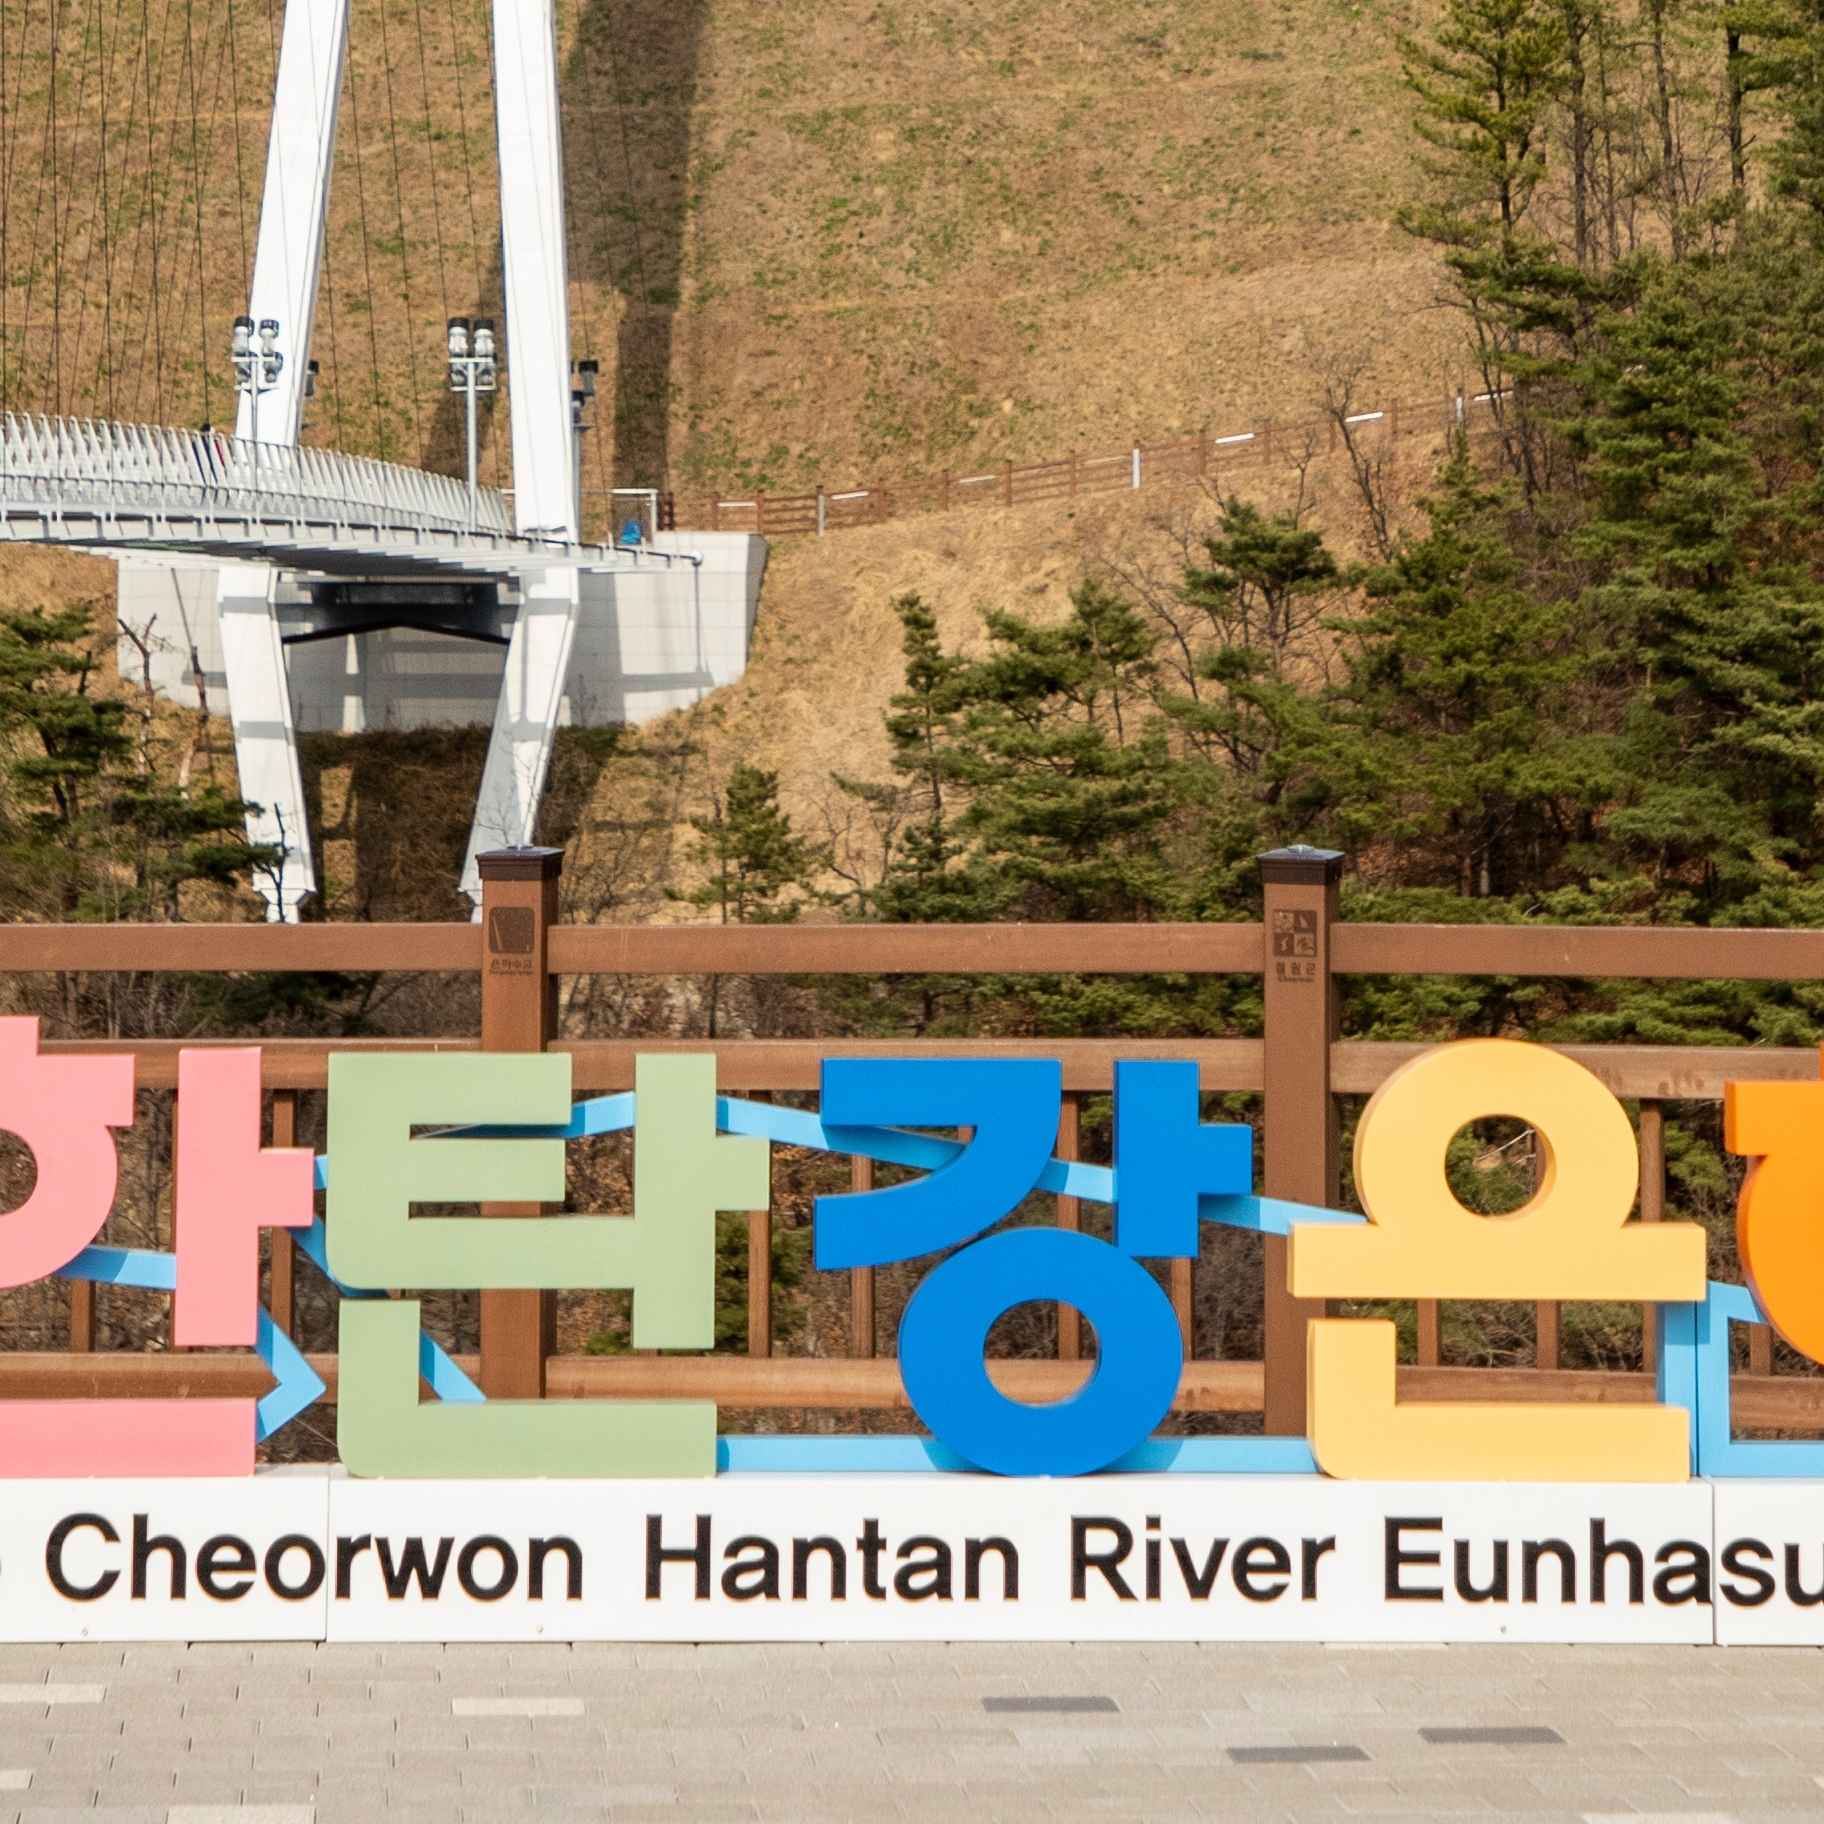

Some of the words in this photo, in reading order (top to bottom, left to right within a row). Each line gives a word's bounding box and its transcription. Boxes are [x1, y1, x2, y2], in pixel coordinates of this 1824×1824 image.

[45, 1513, 583, 1601] Cheorwon
[645, 1515, 1019, 1600] Hantan
[1071, 1516, 1336, 1602] River
